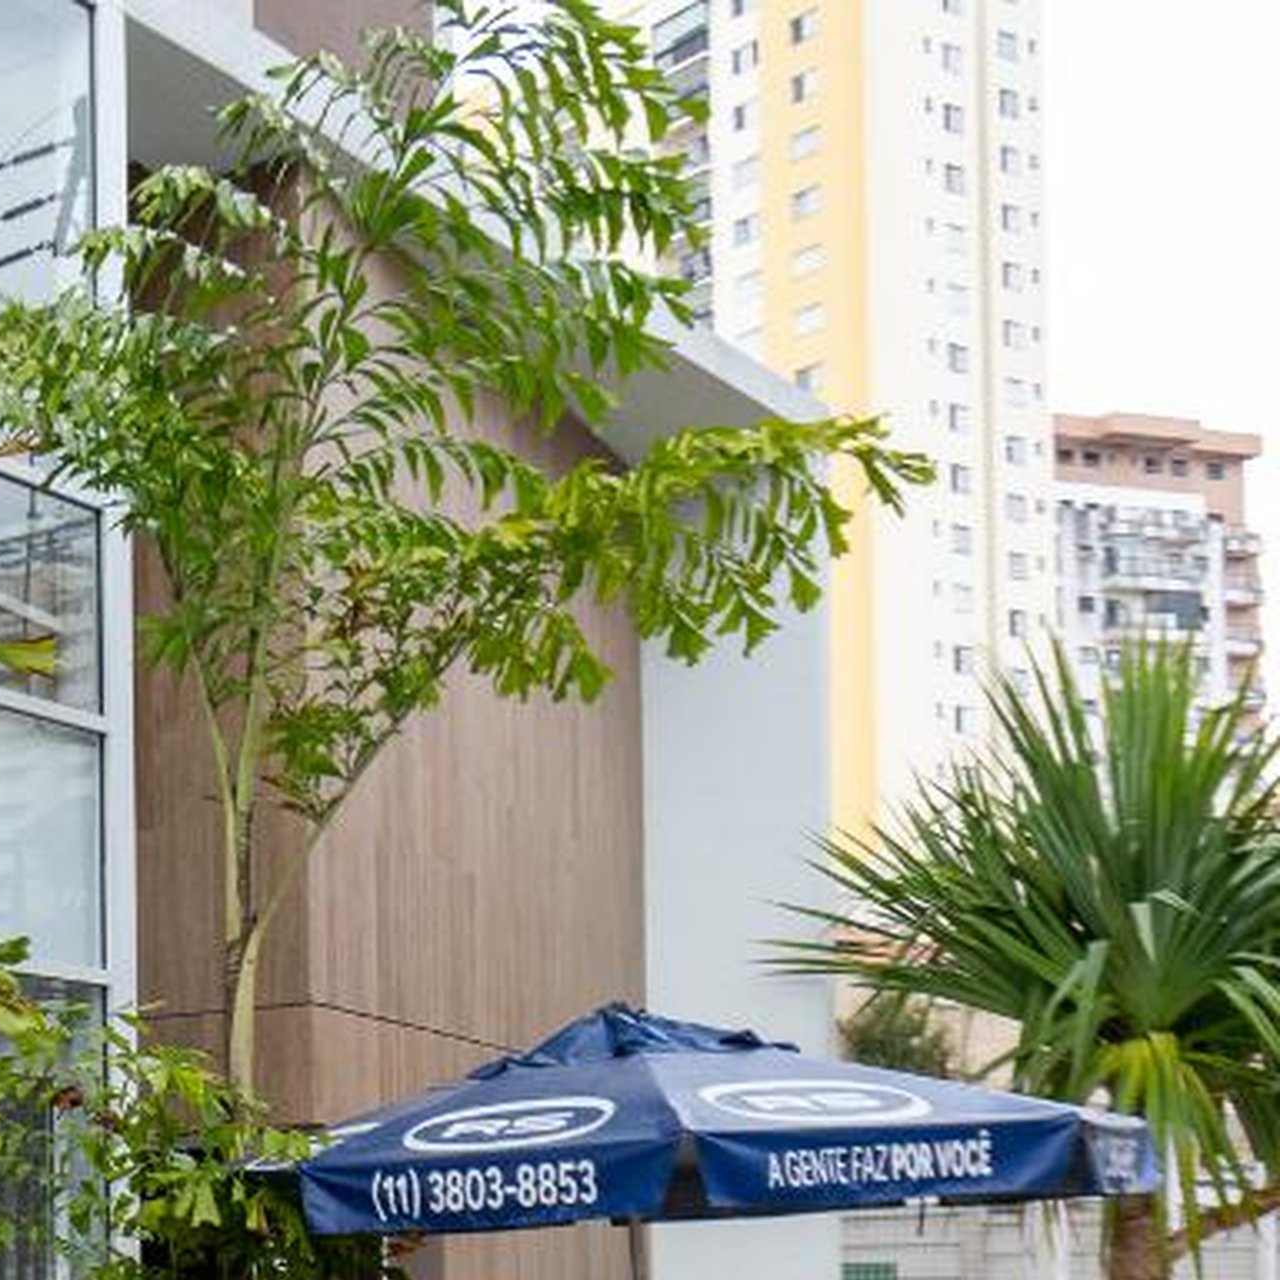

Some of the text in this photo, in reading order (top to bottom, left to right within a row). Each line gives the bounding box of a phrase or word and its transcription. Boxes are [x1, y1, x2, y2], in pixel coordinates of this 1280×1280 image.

[442, 1111, 576, 1138] RS
[768, 1128, 993, 1190] A GENTE FAZ POR VOCÊ
[372, 1159, 598, 1222] (11) 3803-8853
